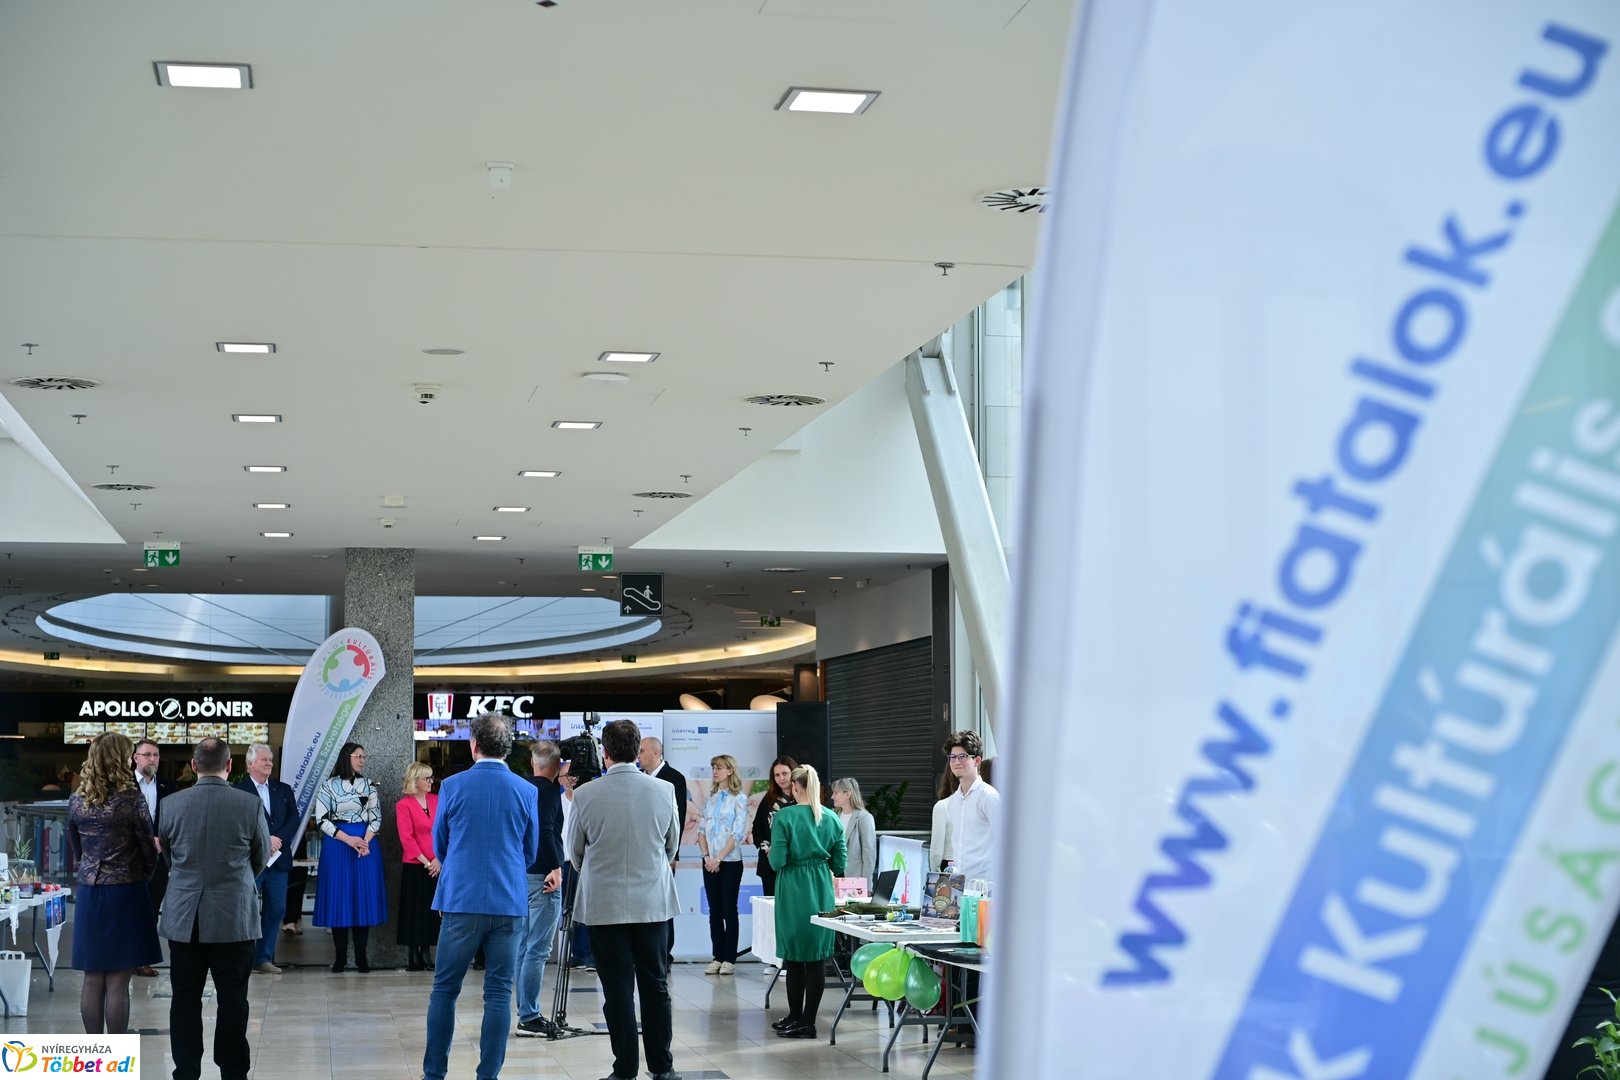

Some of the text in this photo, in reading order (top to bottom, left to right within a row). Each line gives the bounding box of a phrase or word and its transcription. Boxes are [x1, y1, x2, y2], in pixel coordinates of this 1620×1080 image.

[1101, 20, 1609, 987] www.fiatalok.eu
[79, 697, 254, 717] APOLLO DÖNER
[466, 695, 535, 718] KFC
[300, 758, 325, 808] Kultúrális
[321, 702, 352, 758] Szövetsége
